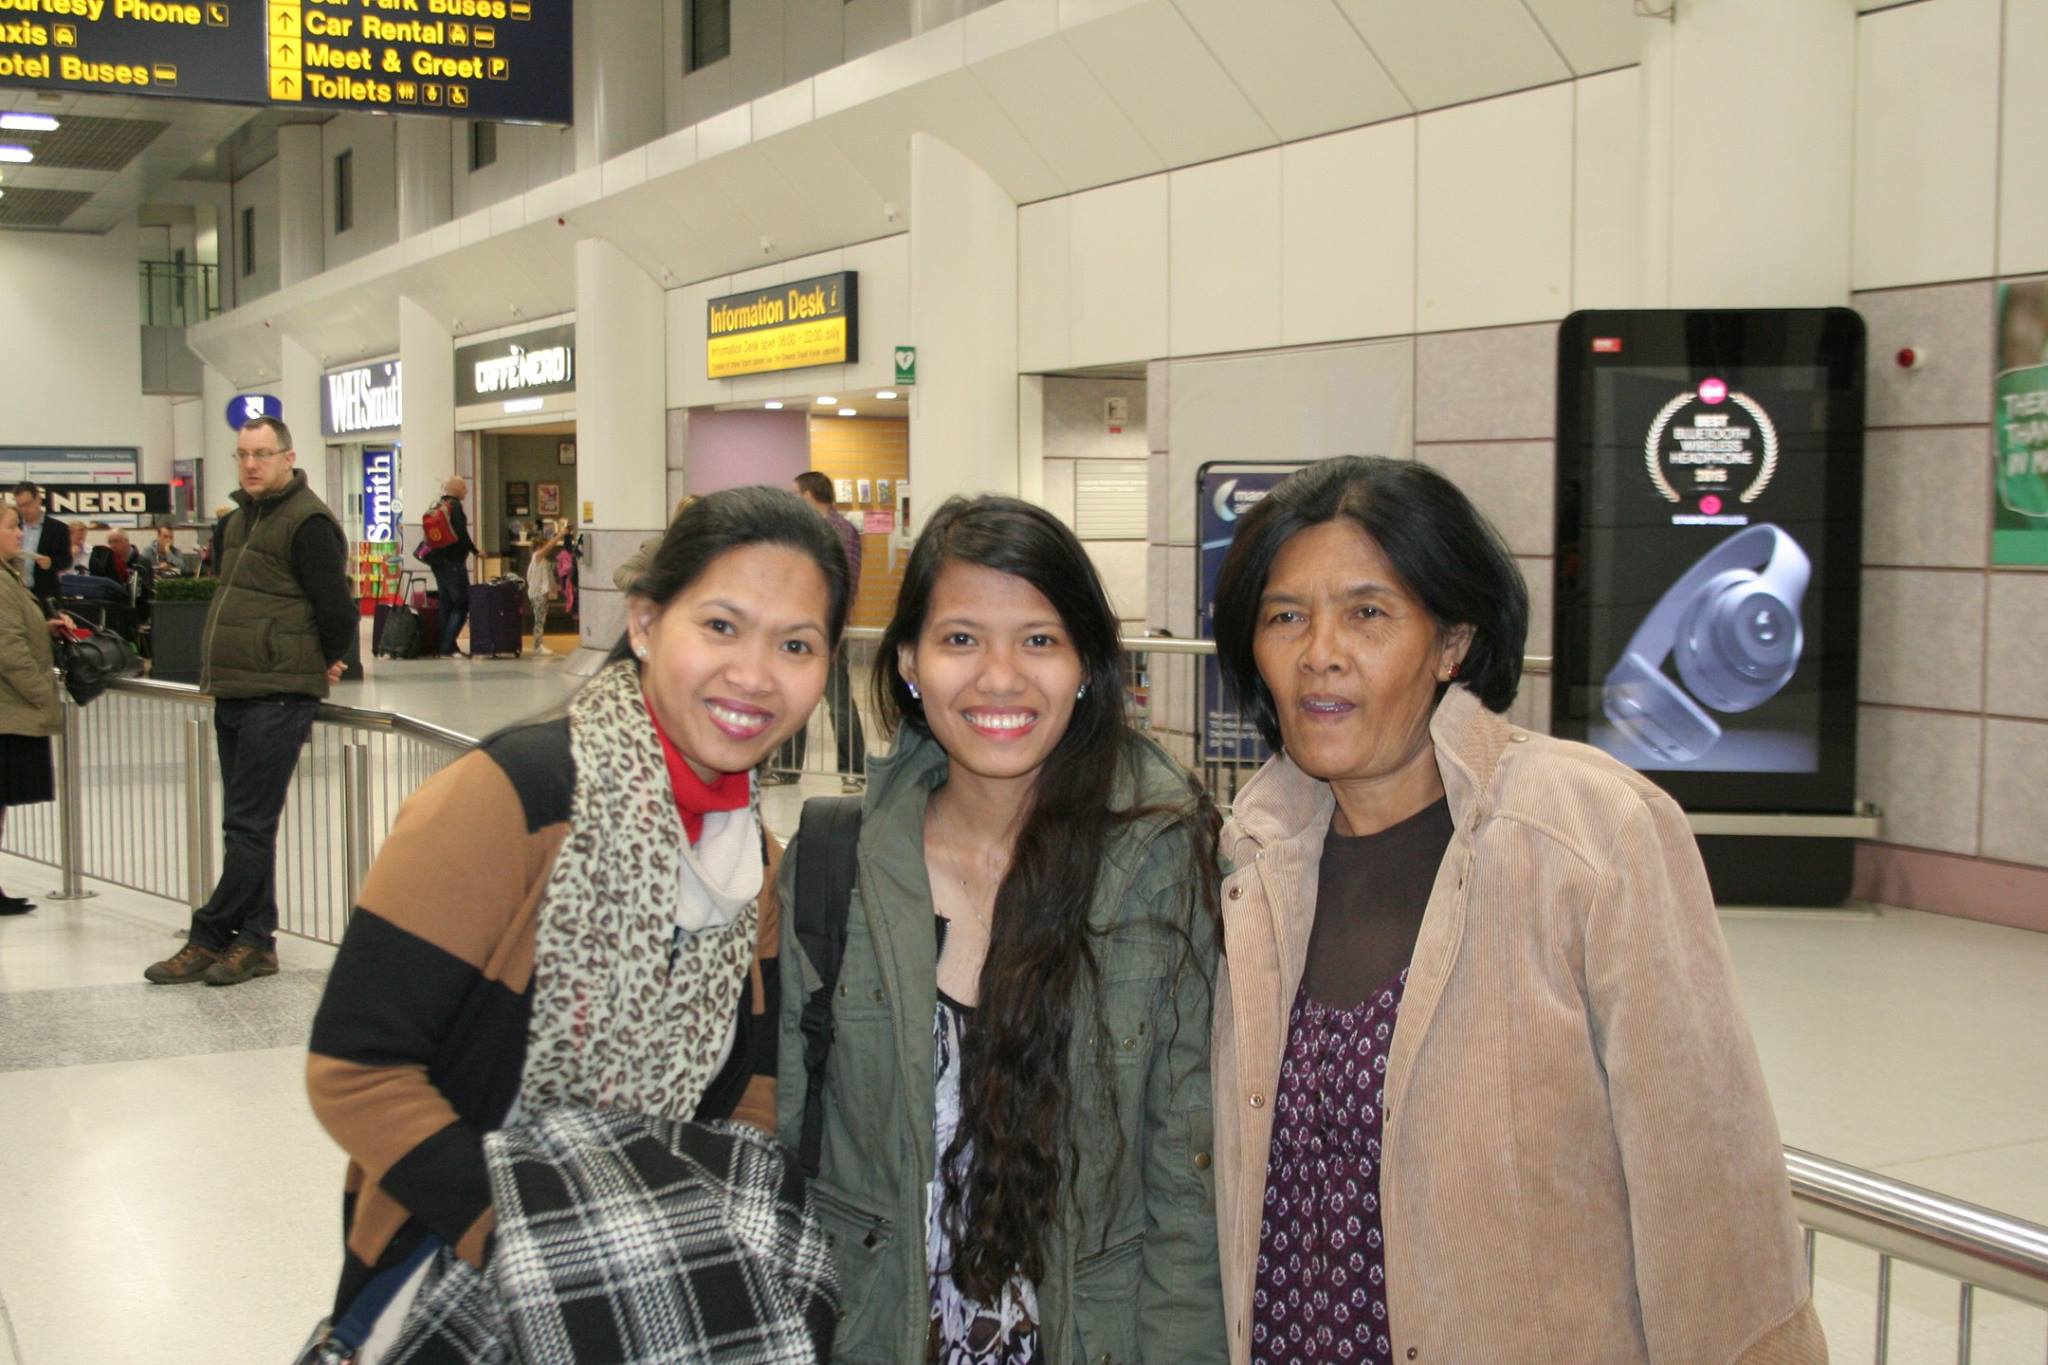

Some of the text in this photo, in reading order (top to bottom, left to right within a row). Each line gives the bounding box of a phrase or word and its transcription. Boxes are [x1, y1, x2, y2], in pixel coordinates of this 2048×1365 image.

[114, 0, 201, 25] Phone
[429, 0, 506, 19] Buses
[305, 10, 443, 44] Car Rental
[60, 55, 149, 86] Buses
[305, 42, 372, 70] Meet
[382, 48, 401, 73] &
[412, 51, 483, 79] Greet
[306, 74, 392, 102] Toilets
[711, 296, 784, 334] Information
[788, 285, 826, 320] Desk
[52, 491, 146, 513] NERO
[366, 454, 391, 542] Smith
